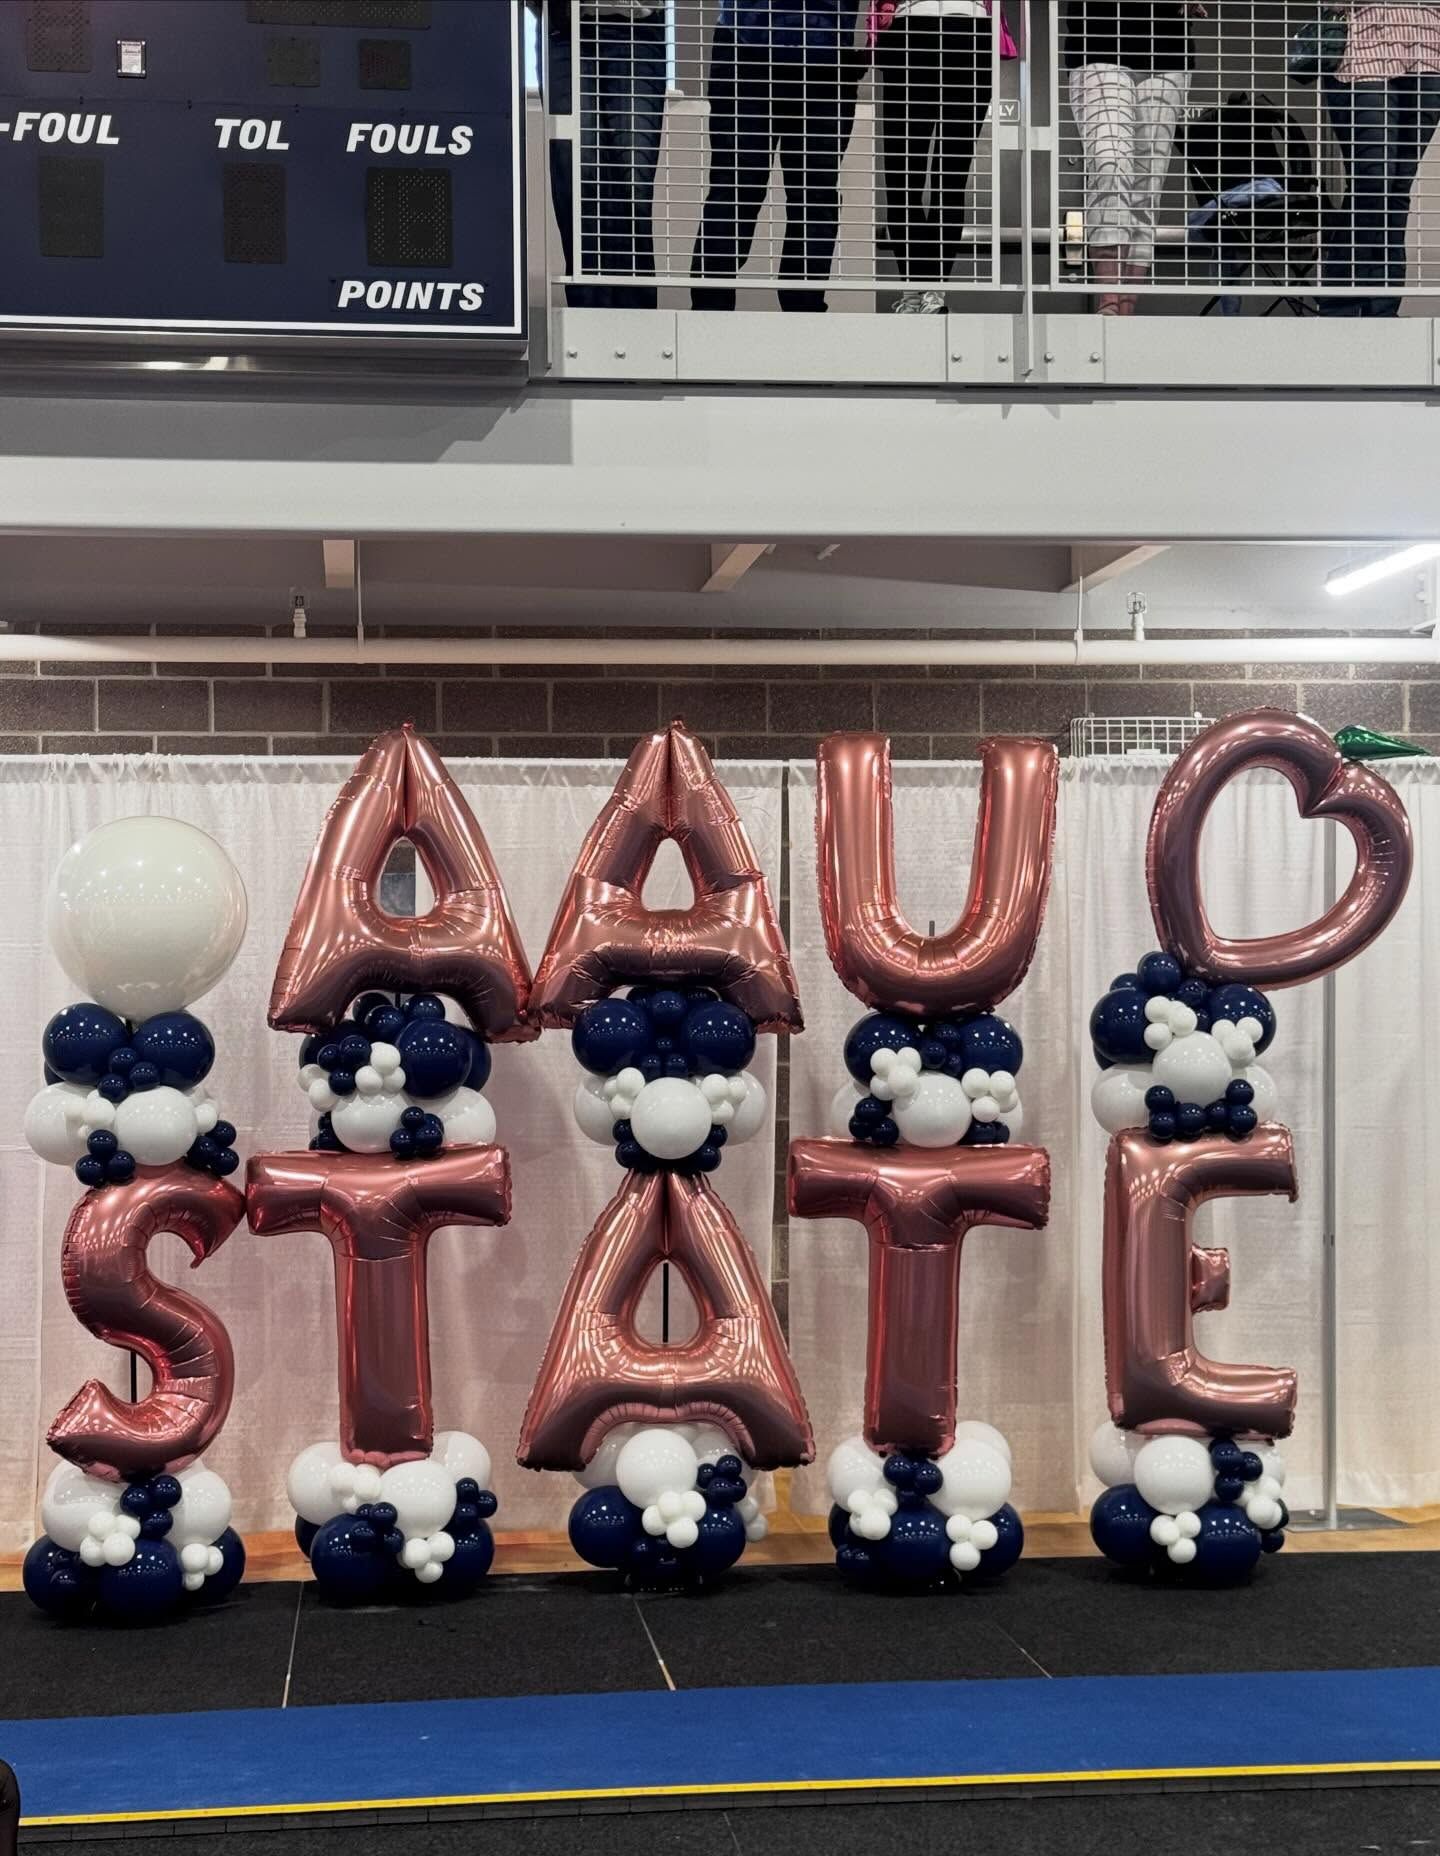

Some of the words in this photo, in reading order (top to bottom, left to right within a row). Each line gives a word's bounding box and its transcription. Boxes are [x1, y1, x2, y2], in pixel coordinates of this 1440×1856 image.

[214, 118, 290, 150] TOL
[346, 123, 473, 155] FOULS
[337, 280, 485, 311] POINTS
[47, 1121, 1298, 1483] STATE
